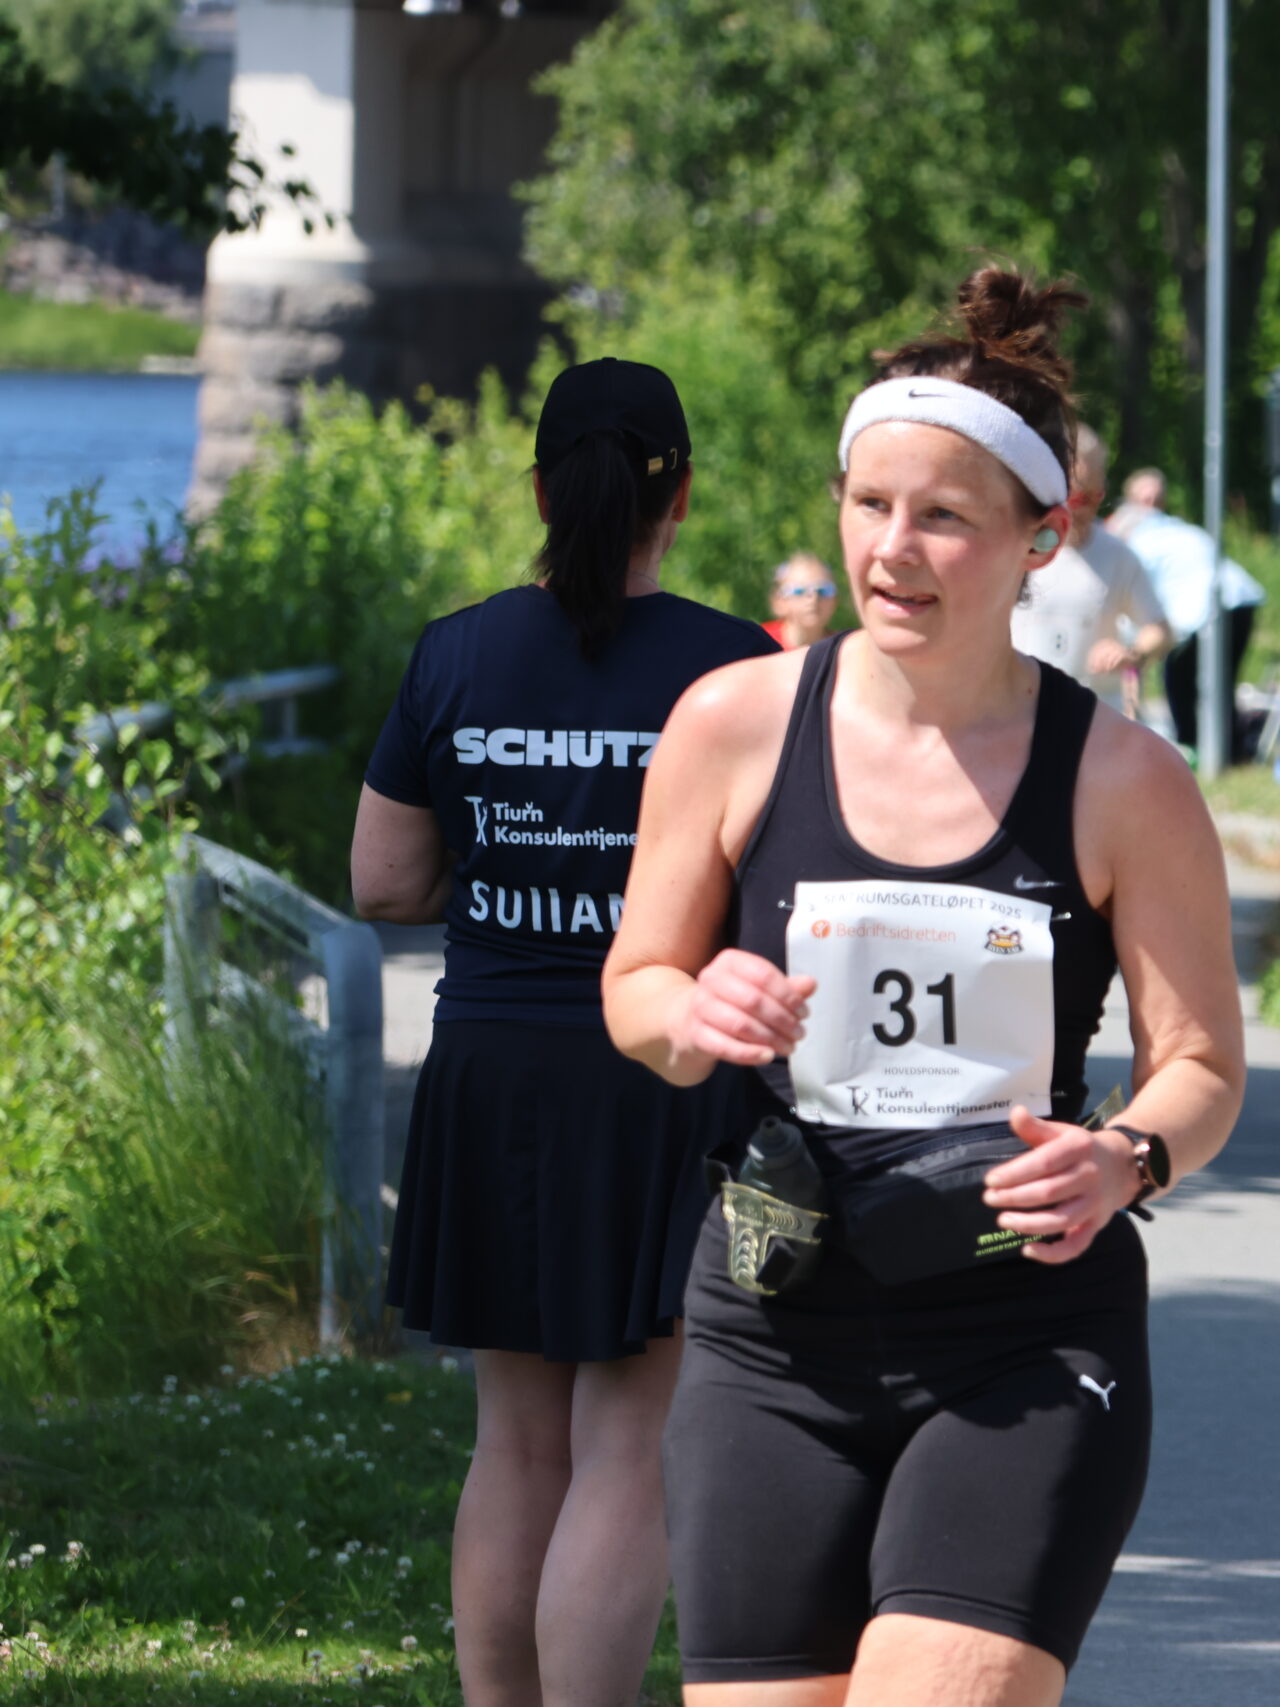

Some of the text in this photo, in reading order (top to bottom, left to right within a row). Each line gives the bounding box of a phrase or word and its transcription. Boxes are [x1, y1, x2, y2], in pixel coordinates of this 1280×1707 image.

[825, 891, 1022, 919] SENRUMSGATELØPET 2025
[836, 922, 956, 942] Bedriftsidretten
[872, 968, 957, 1047] 31
[876, 1099, 1012, 1117] Konsulenttjenester
